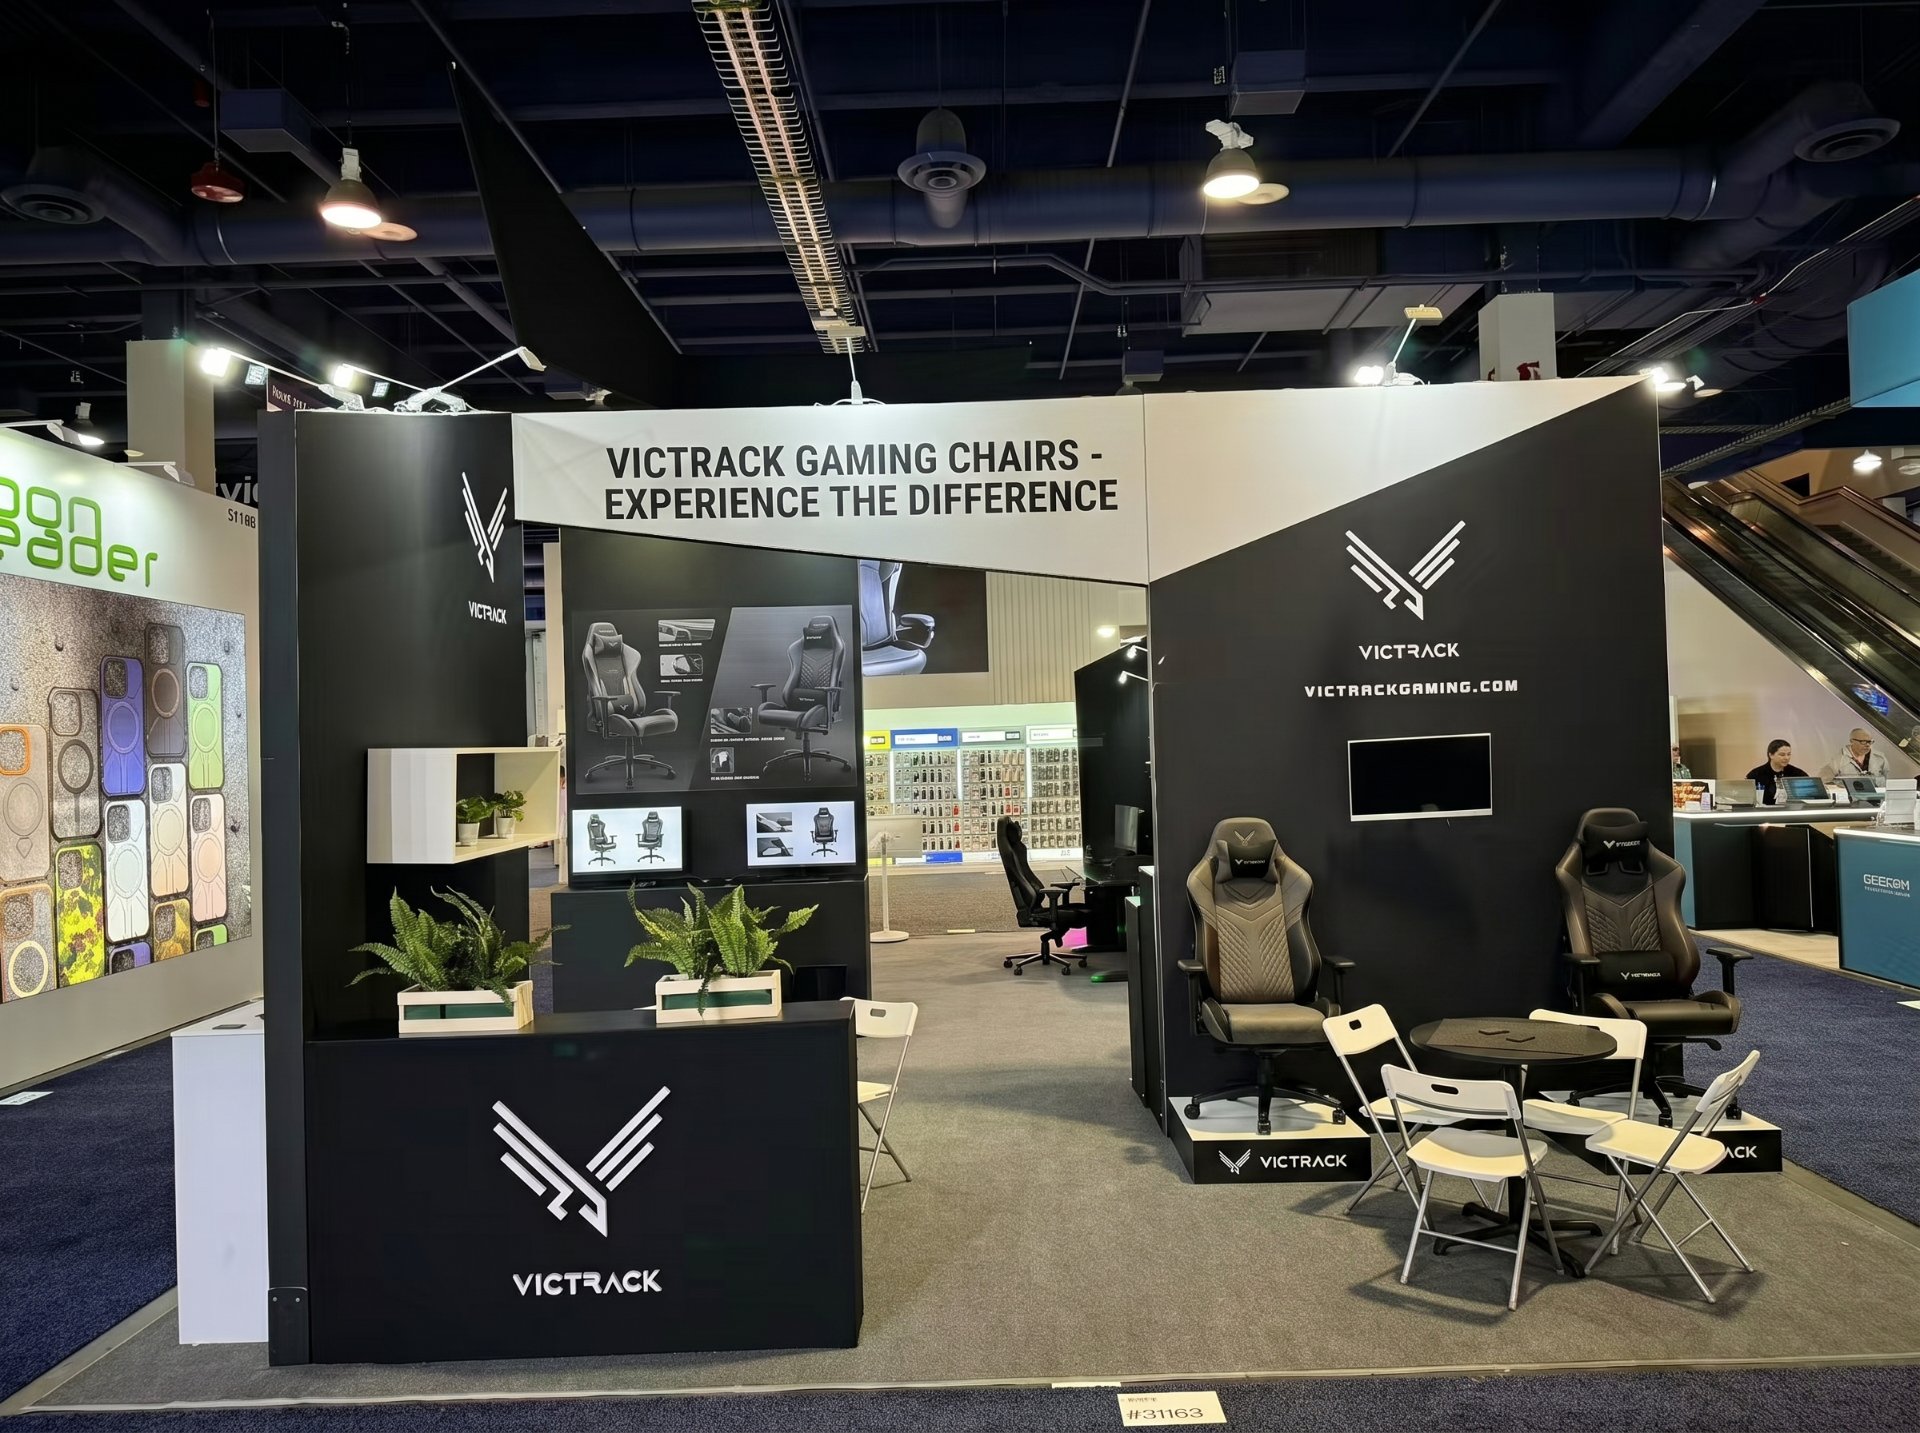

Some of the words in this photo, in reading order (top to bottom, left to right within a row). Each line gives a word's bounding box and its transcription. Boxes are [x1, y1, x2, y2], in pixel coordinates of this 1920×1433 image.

[605, 445, 786, 479] VICTRACK
[796, 441, 937, 476] GAMING
[948, 439, 1080, 474] CHAIRS
[604, 486, 820, 520] EXPERIENCE
[829, 485, 898, 517] THE
[909, 479, 1119, 515] DIFFERENCE
[468, 600, 507, 625] VICTRACK
[1358, 642, 1460, 660] VICTRACK
[1304, 679, 1518, 698] VICTRACKGAMING.COM
[1260, 1154, 1348, 1169] VICTRACK
[512, 1268, 663, 1296] VICTRACK
[1126, 1407, 1204, 1420] #31163
